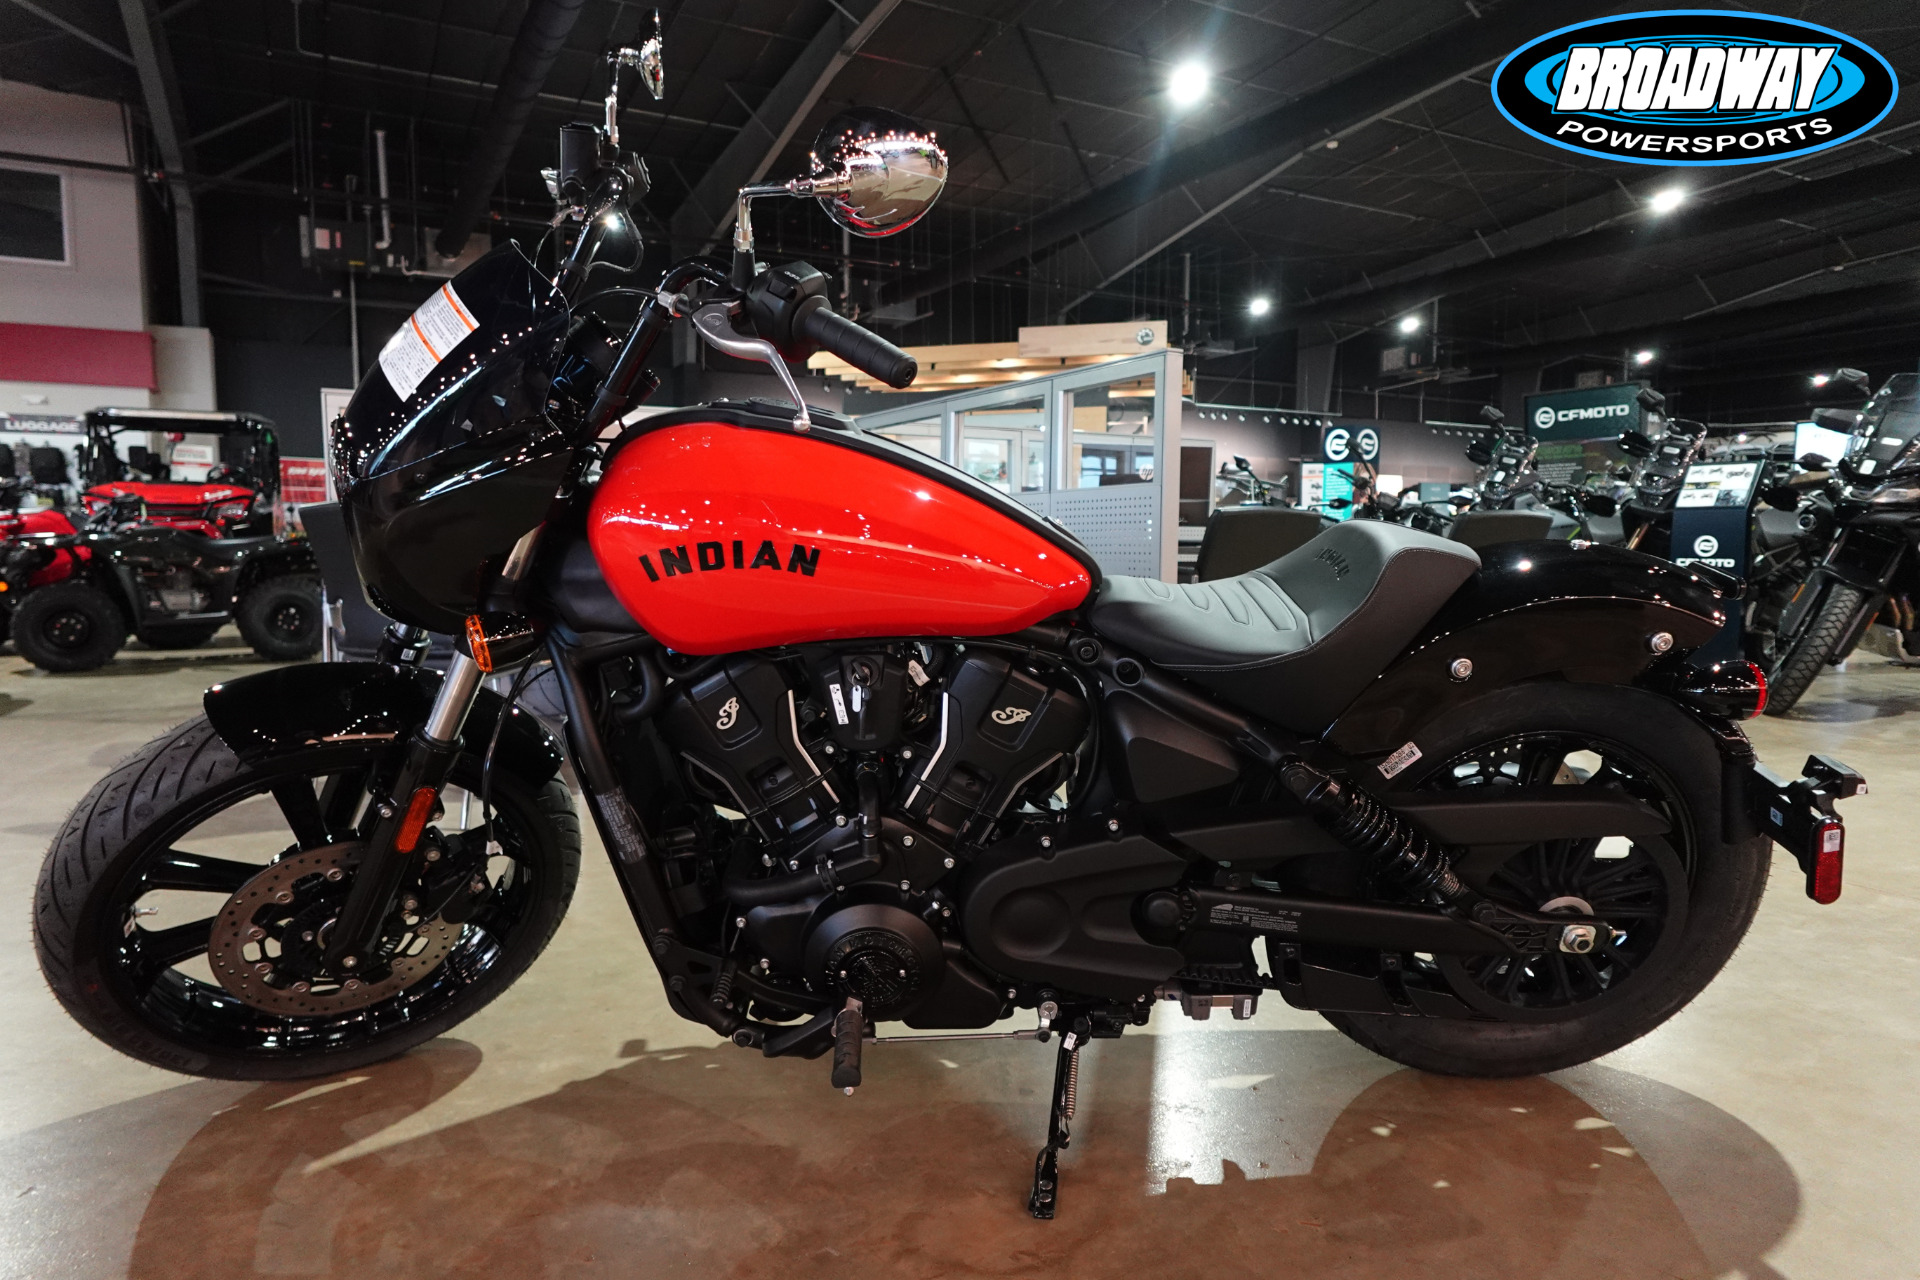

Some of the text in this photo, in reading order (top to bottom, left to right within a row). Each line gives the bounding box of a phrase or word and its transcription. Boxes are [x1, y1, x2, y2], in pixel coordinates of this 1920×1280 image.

[1557, 404, 1630, 421] CFMOTO
[5, 420, 80, 431] LUGGAGE
[638, 540, 821, 582] INDIAN
